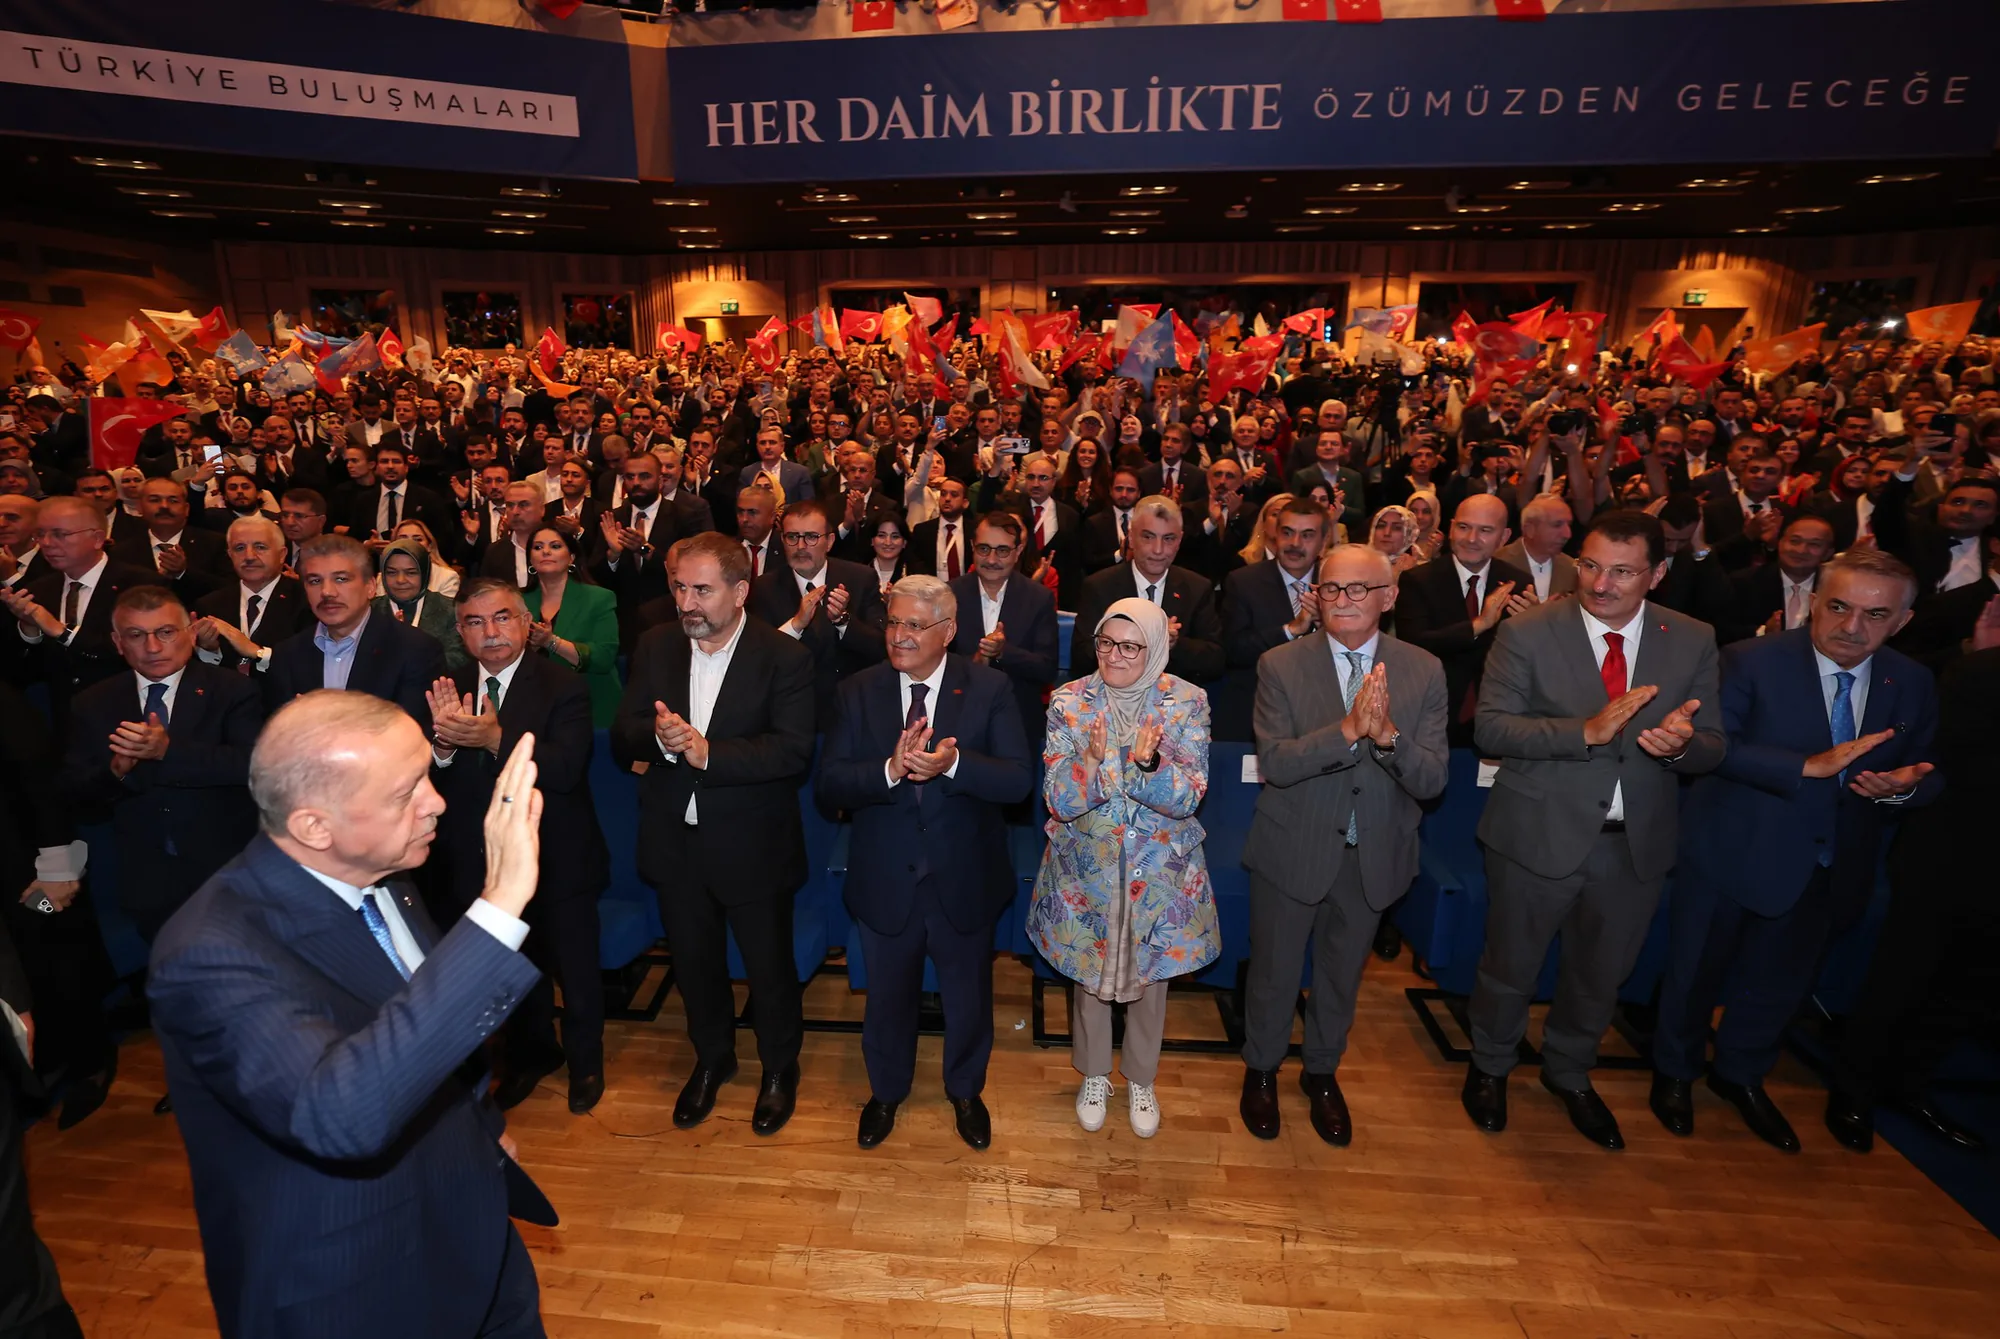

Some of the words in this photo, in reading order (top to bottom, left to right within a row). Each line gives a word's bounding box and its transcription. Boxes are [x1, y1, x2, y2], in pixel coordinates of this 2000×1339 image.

[21, 46, 238, 91] TÜRKİYE
[267, 74, 554, 122] BULUŞMALARI
[703, 99, 825, 147] HER
[837, 82, 993, 142] DAİM
[1009, 75, 1283, 136] BİRLİKTE
[1313, 84, 1640, 120] ÖZÜMÜZDEN
[1676, 71, 1970, 112] GELECEĞE
